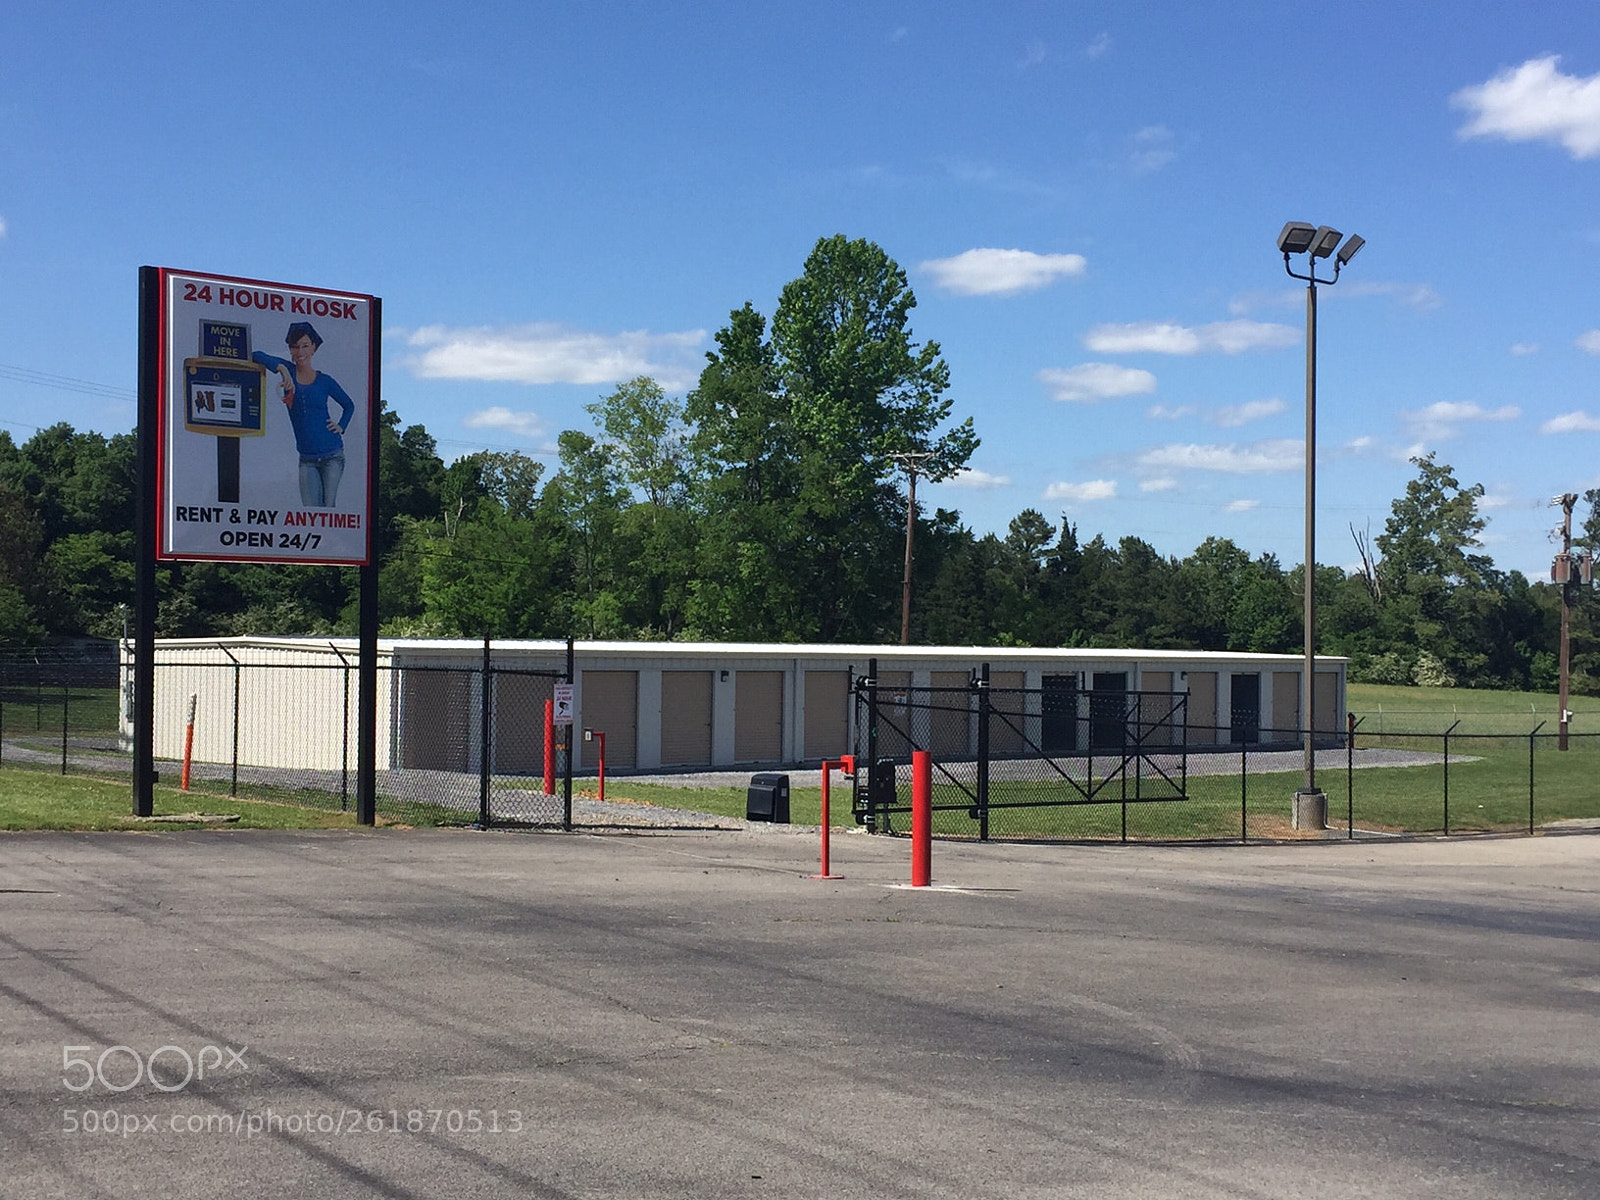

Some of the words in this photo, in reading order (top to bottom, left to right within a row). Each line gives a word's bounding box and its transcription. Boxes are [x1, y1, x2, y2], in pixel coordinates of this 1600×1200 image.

[183, 283, 212, 303] 24
[219, 287, 284, 312] HOUR
[291, 296, 357, 320] KIOSK
[210, 326, 240, 337] MOVE
[220, 337, 231, 346] IN
[213, 346, 238, 358] HERE
[176, 506, 223, 523] RENT
[229, 508, 241, 524] &
[247, 509, 278, 526] PAY
[283, 511, 361, 529] ANYTIME!
[219, 530, 273, 547] OPEN
[278, 532, 322, 550] 24/7
